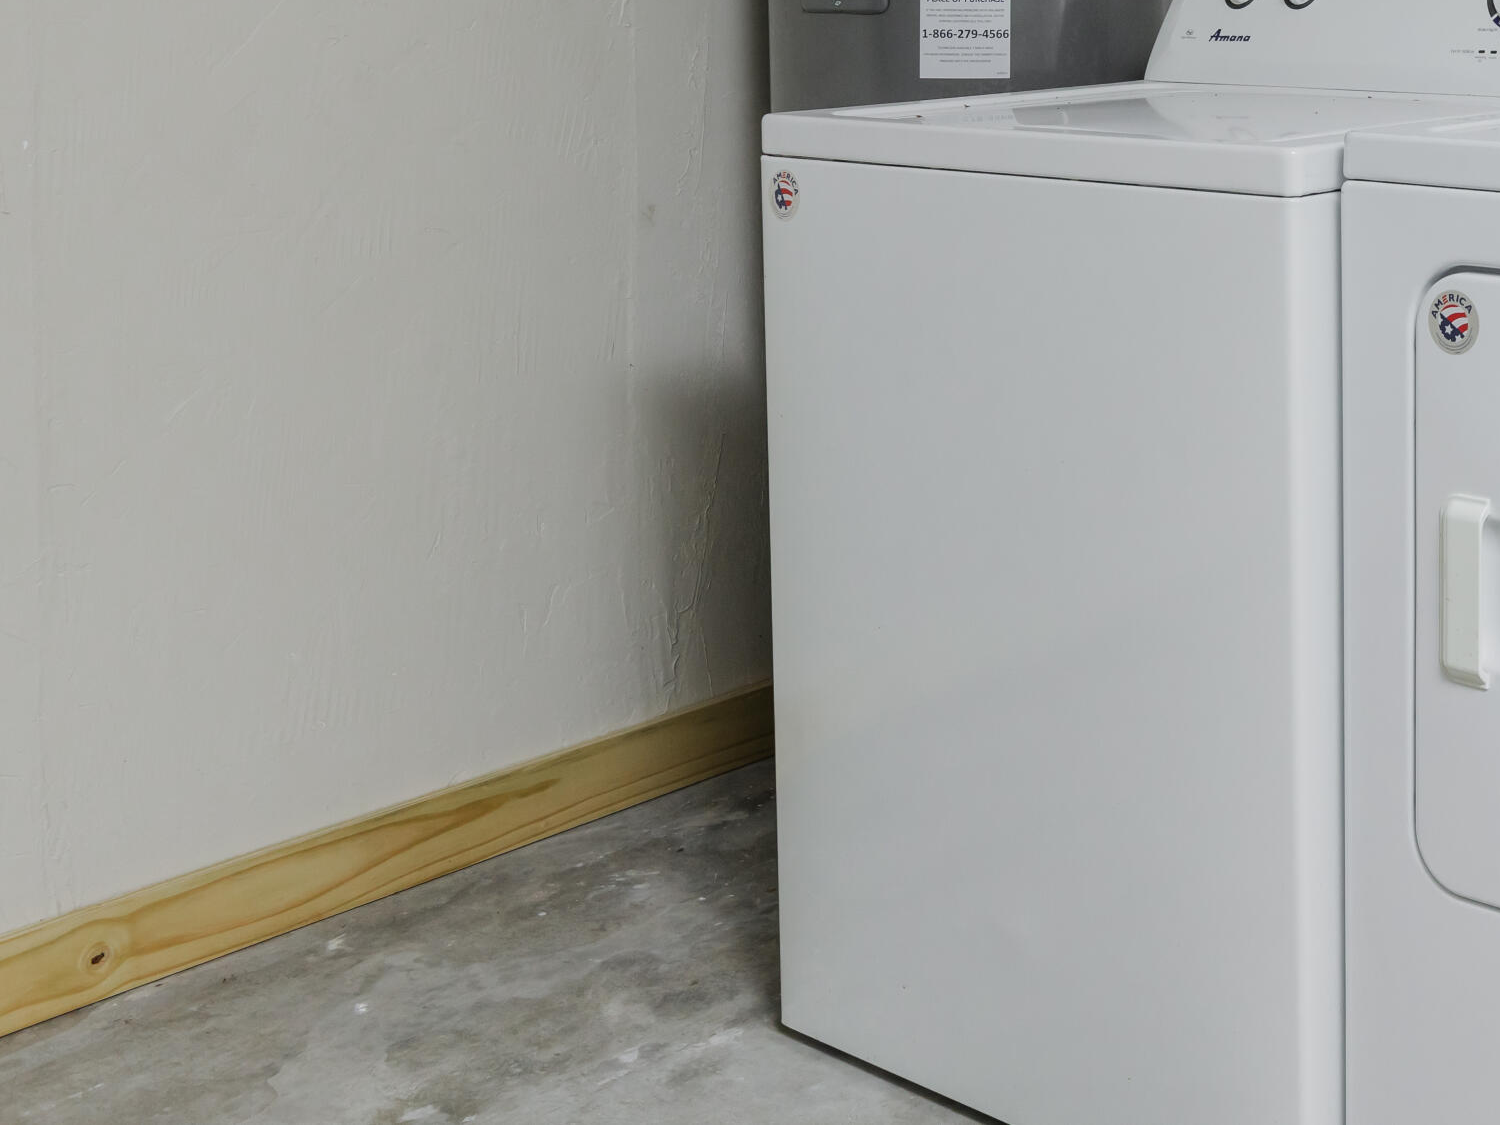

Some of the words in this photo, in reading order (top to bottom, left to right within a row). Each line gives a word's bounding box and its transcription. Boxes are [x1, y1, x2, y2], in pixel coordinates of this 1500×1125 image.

[922, 29, 1009, 39] 1-866-279-4566
[1208, 28, 1251, 42] Amana
[1431, 293, 1473, 320] AMERICA
